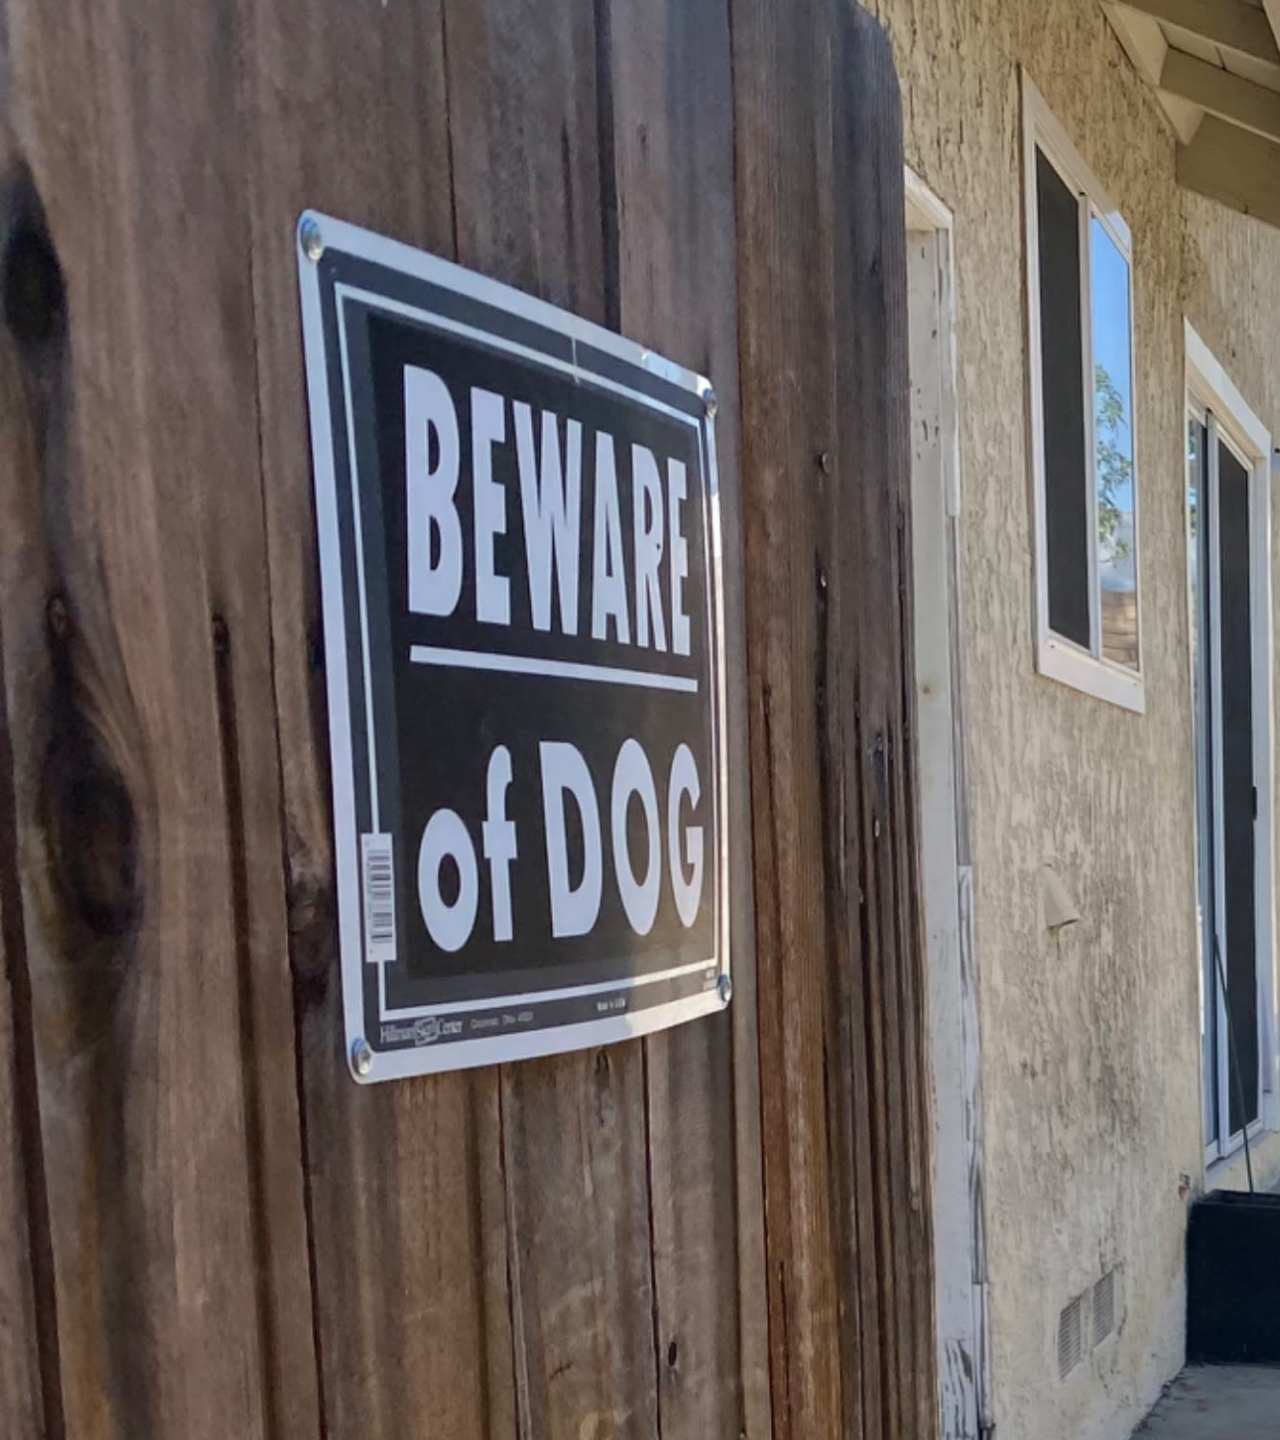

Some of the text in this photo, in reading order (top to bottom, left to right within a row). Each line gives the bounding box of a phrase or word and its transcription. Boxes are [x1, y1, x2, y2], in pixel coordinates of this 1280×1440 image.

[403, 363, 692, 658] BEWARE
[418, 738, 705, 953] of DOG
